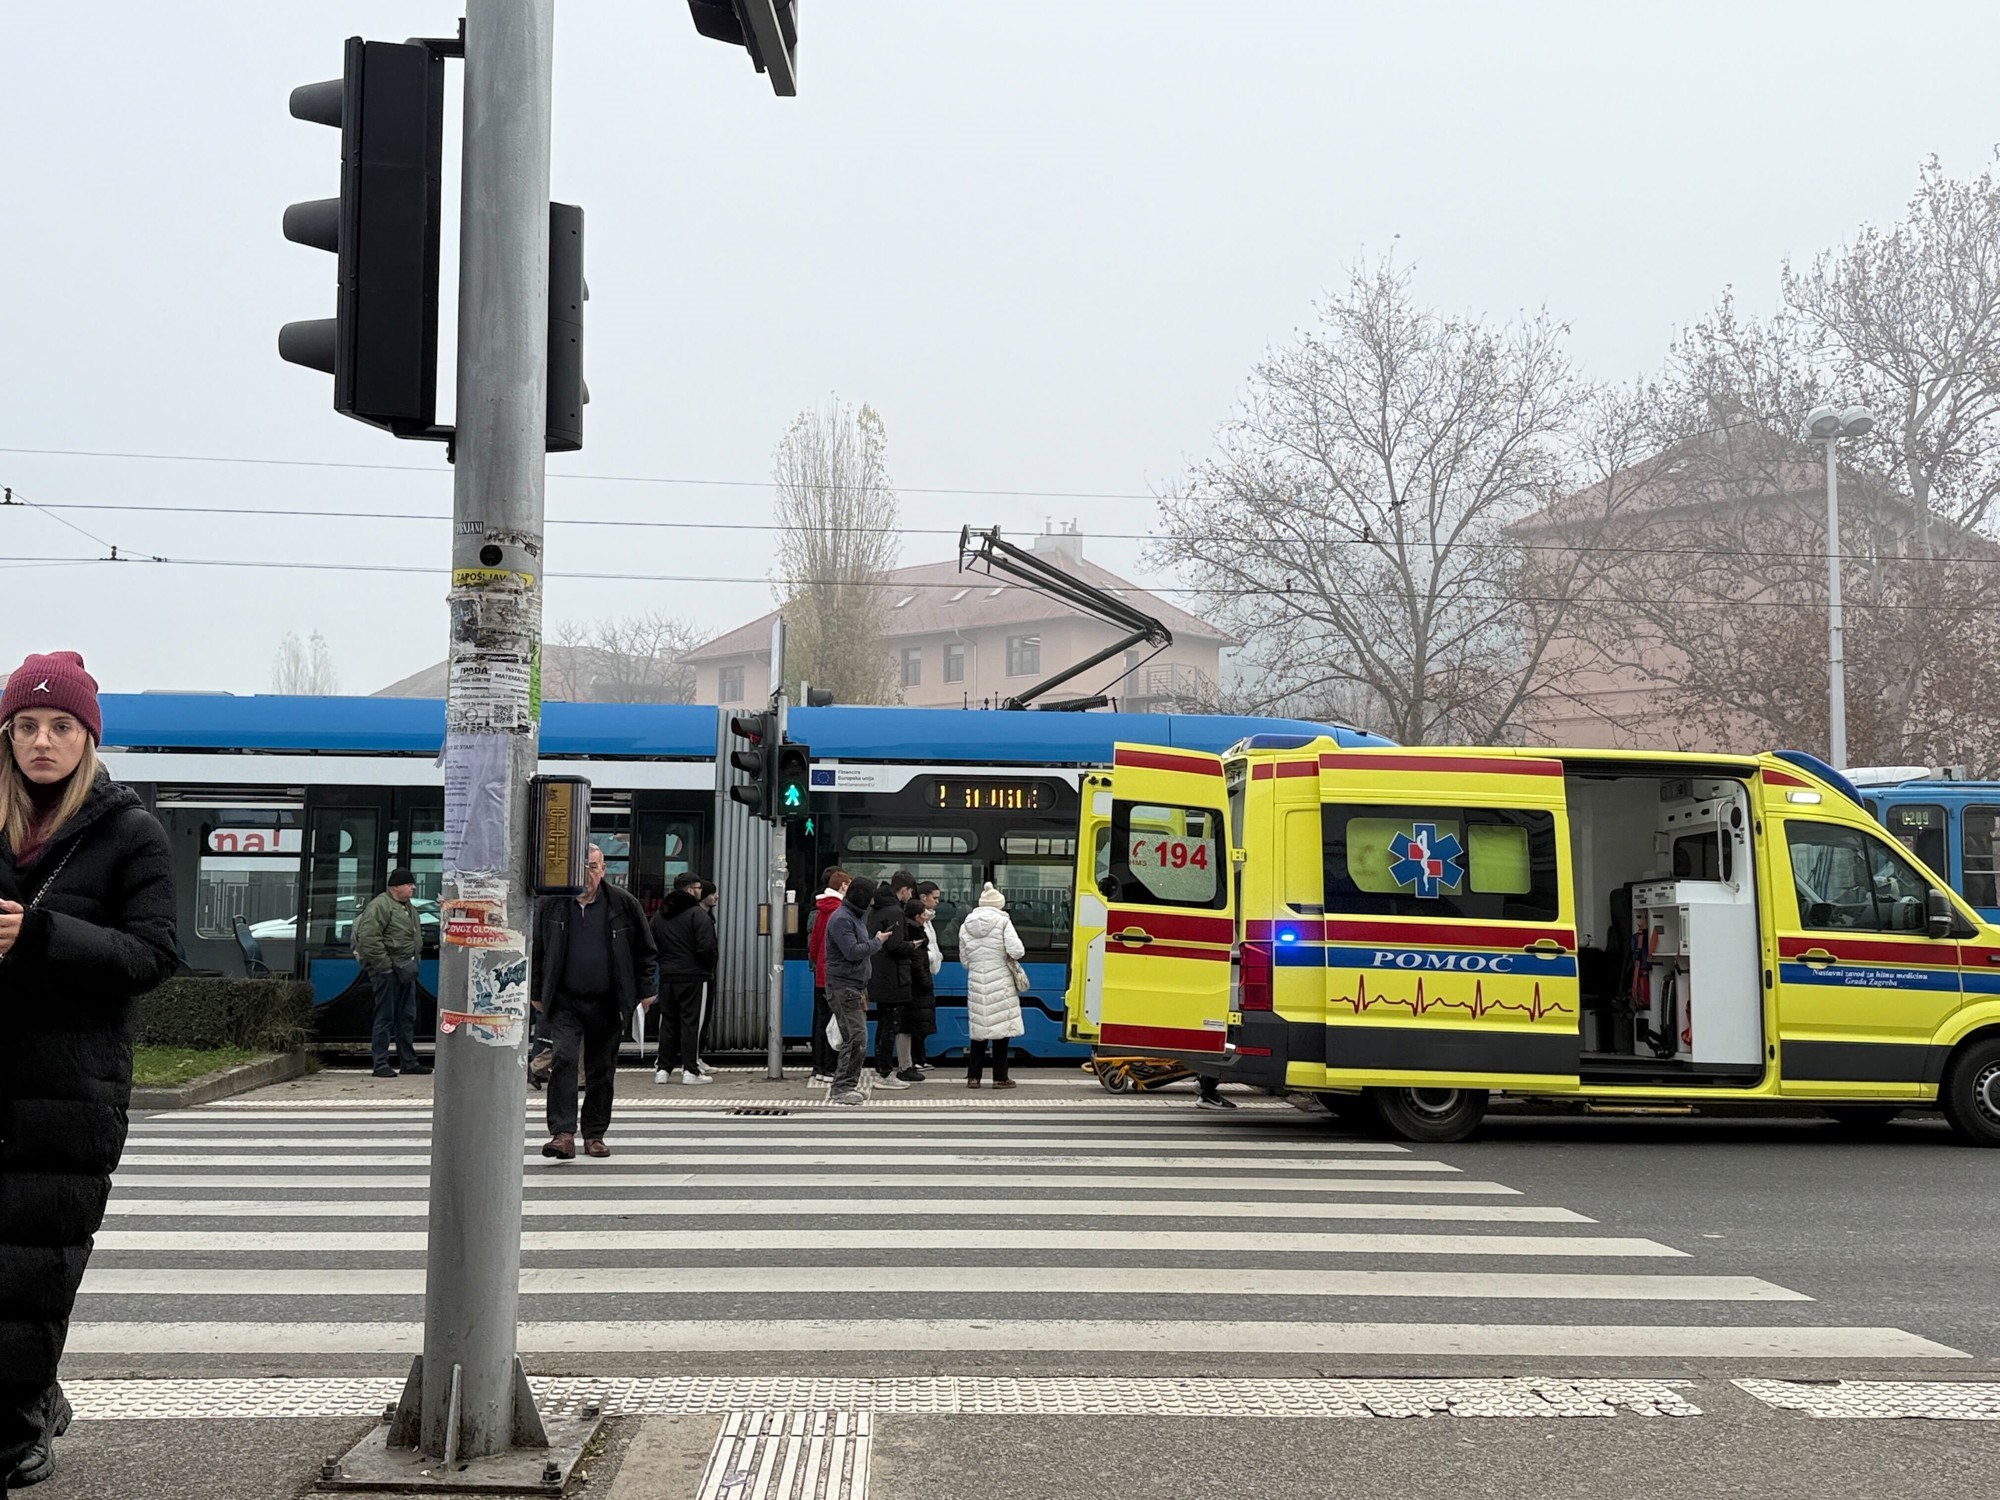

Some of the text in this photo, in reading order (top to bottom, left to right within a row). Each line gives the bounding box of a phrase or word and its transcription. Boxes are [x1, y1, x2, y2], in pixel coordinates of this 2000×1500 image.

[1155, 842, 1208, 870] 194
[1372, 951, 1514, 973] POMOĆ
[1812, 969, 1843, 977] Nastavni
[1845, 977, 1897, 987] Grada Zagreba
